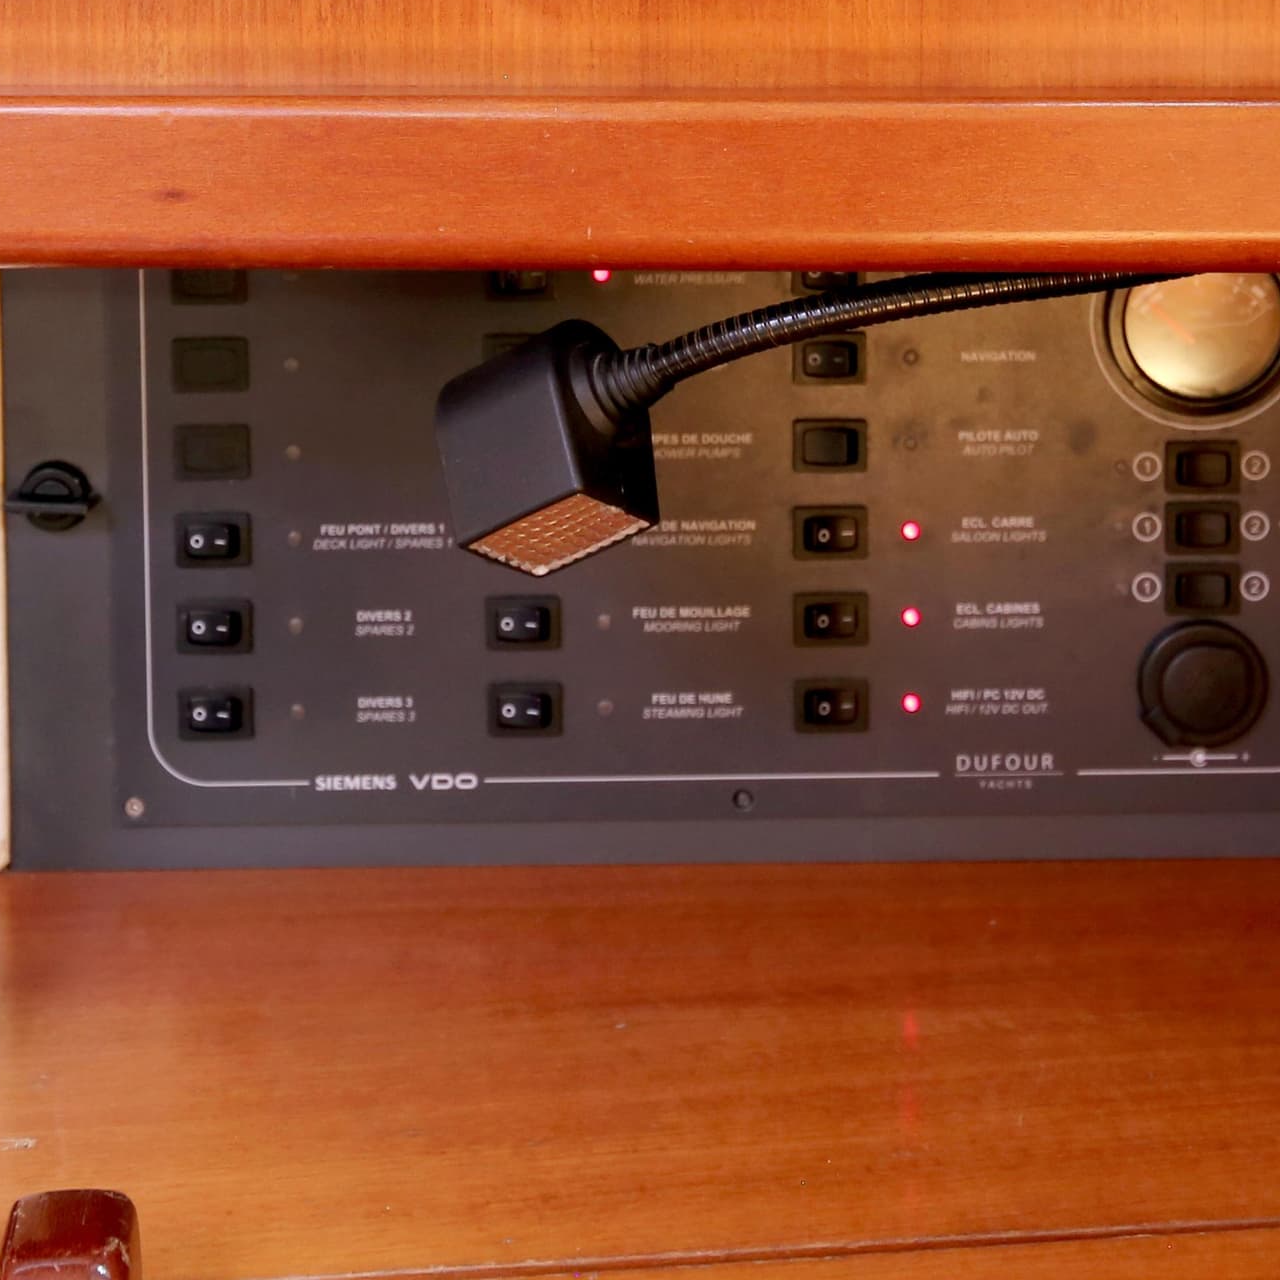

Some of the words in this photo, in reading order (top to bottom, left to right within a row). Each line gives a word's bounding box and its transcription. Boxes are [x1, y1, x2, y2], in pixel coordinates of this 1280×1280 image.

[634, 273, 677, 285] WATER
[679, 272, 746, 285] PRESSURE
[961, 350, 1036, 363] NAVIGATION
[681, 433, 698, 445] DE
[701, 433, 753, 444] DOUCHE
[958, 430, 1001, 443] PILOTE
[1004, 430, 1040, 443] AUTO
[697, 447, 741, 458] PUMPS
[962, 444, 995, 456] AUTO
[996, 444, 1034, 456] PILOT
[321, 525, 345, 536] FEU
[347, 525, 381, 536] PONT
[391, 524, 432, 535] DIVERS
[661, 520, 678, 532] DE
[680, 519, 757, 531] NAVIGATION
[632, 535, 706, 547] NAVIGATION
[707, 534, 752, 546] LIGHTS
[1003, 530, 1048, 542] LIGHTS
[313, 539, 342, 550] DECK
[345, 538, 383, 550] LIGHT
[394, 538, 443, 549] SPARES
[632, 607, 658, 619] FEU
[660, 607, 677, 619] DE
[679, 606, 752, 618] MOUILLAGE
[986, 602, 1041, 615] CABINES
[356, 611, 401, 622] DIVERS
[1000, 616, 1045, 628] LIGHTS
[354, 624, 403, 636] SPARES
[643, 621, 699, 633] MOORING
[701, 621, 742, 632] LIGHT
[651, 693, 677, 705] FEU
[679, 693, 696, 705] DE
[698, 692, 733, 704] HUNE
[1027, 689, 1045, 701] DC
[357, 697, 402, 709] DIVERS
[1022, 703, 1049, 715] OUT
[356, 711, 404, 722] SPARES
[642, 707, 705, 720] STEAMING
[707, 706, 744, 718] LIGHT
[955, 753, 1055, 772] DUFOUR
[314, 774, 397, 791] SIEMENS
[409, 773, 479, 790] VDO
[979, 779, 1033, 790] YACHTS
